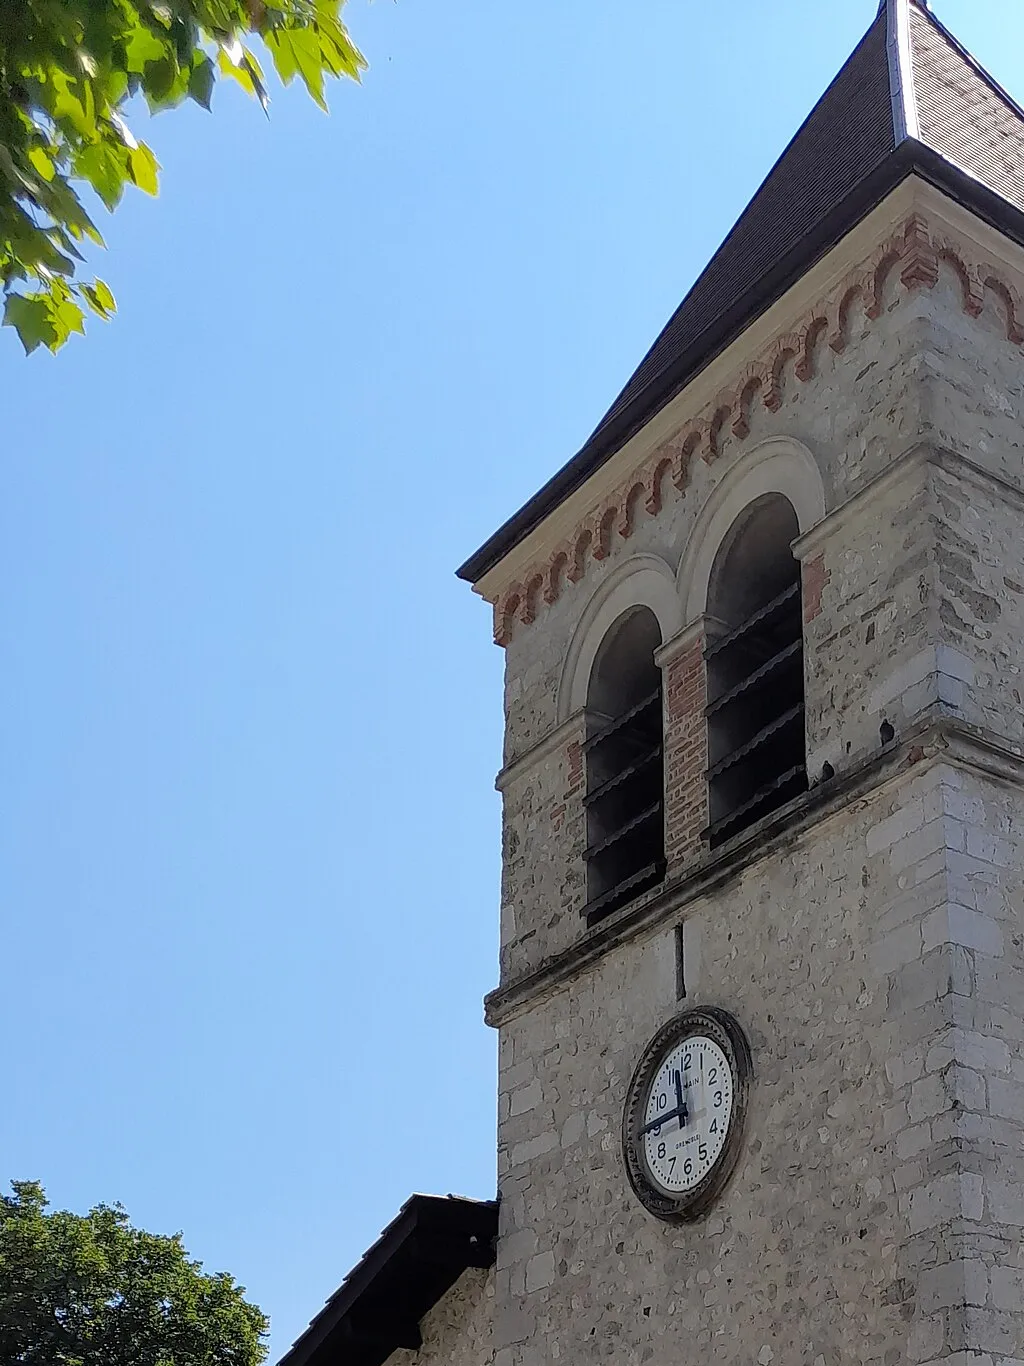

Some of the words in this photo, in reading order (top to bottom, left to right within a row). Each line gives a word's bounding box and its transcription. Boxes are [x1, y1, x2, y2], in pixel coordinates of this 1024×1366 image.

[680, 1053, 692, 1073] 12
[699, 1052, 703, 1071] 1
[668, 1068, 675, 1086] 11
[708, 1068, 718, 1086] 2
[656, 1093, 667, 1112] 10
[713, 1090, 723, 1108] 3
[709, 1117, 718, 1135] 4
[657, 1142, 667, 1159] 8
[698, 1142, 708, 1161] 5
[667, 1156, 677, 1176] 7
[683, 1158, 693, 1175] 6
